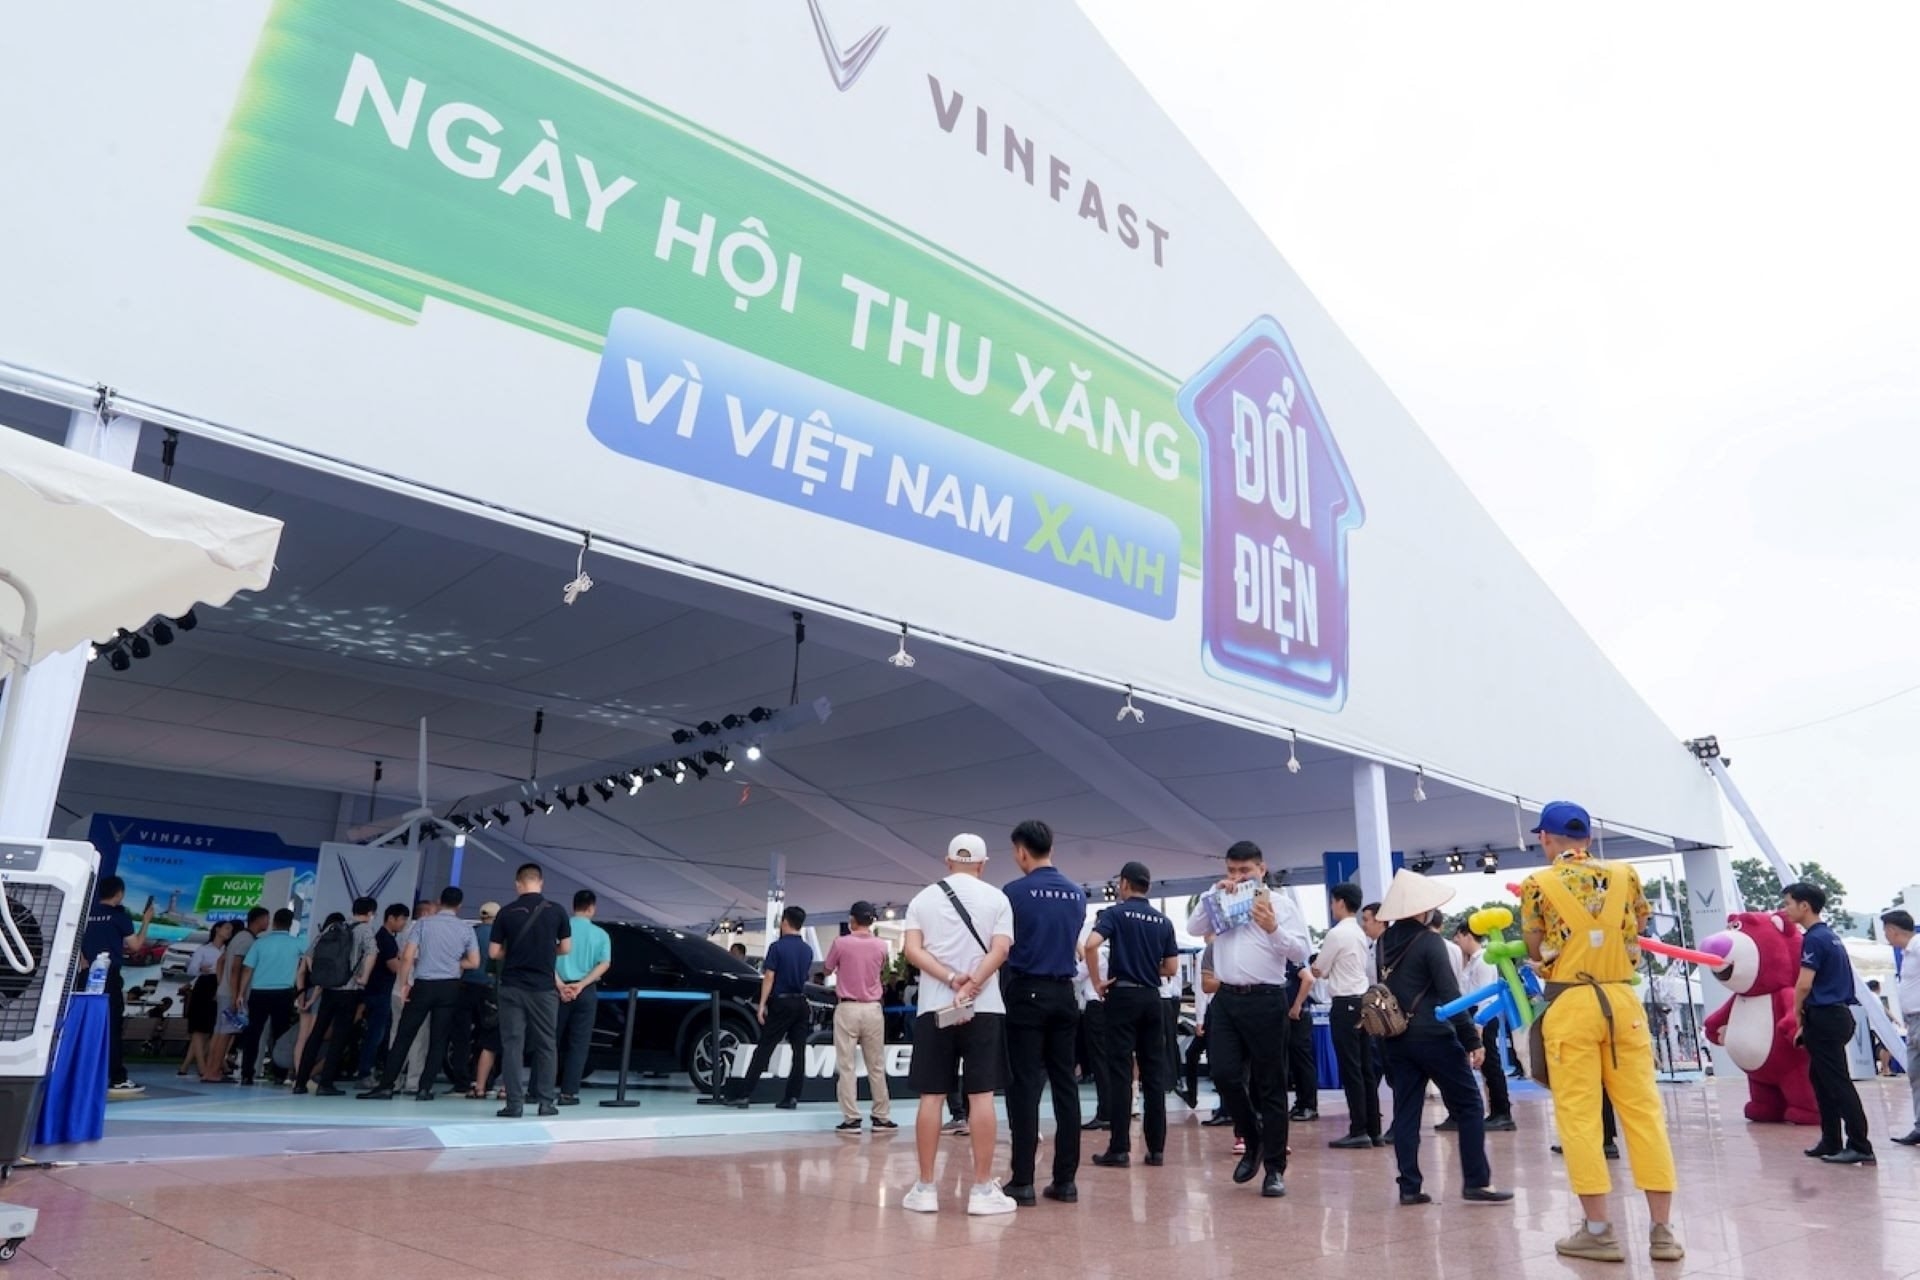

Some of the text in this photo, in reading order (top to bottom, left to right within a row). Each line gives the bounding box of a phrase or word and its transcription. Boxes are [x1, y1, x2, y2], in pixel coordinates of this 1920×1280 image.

[927, 73, 1169, 268] VINFAST
[334, 51, 1180, 481] NGÀY HỘI THU XĂNG
[625, 357, 1165, 597] VÌ VIỆT NAM XANH
[1231, 376, 1312, 530] ĐỔI
[1233, 533, 1319, 655] ĐIỆN
[140, 831, 215, 847] VINFAST
[211, 895, 242, 906] THU
[222, 879, 257, 890] NGÀY
[1030, 888, 1081, 901] VINFAST
[1124, 911, 1164, 924] VINFAST
